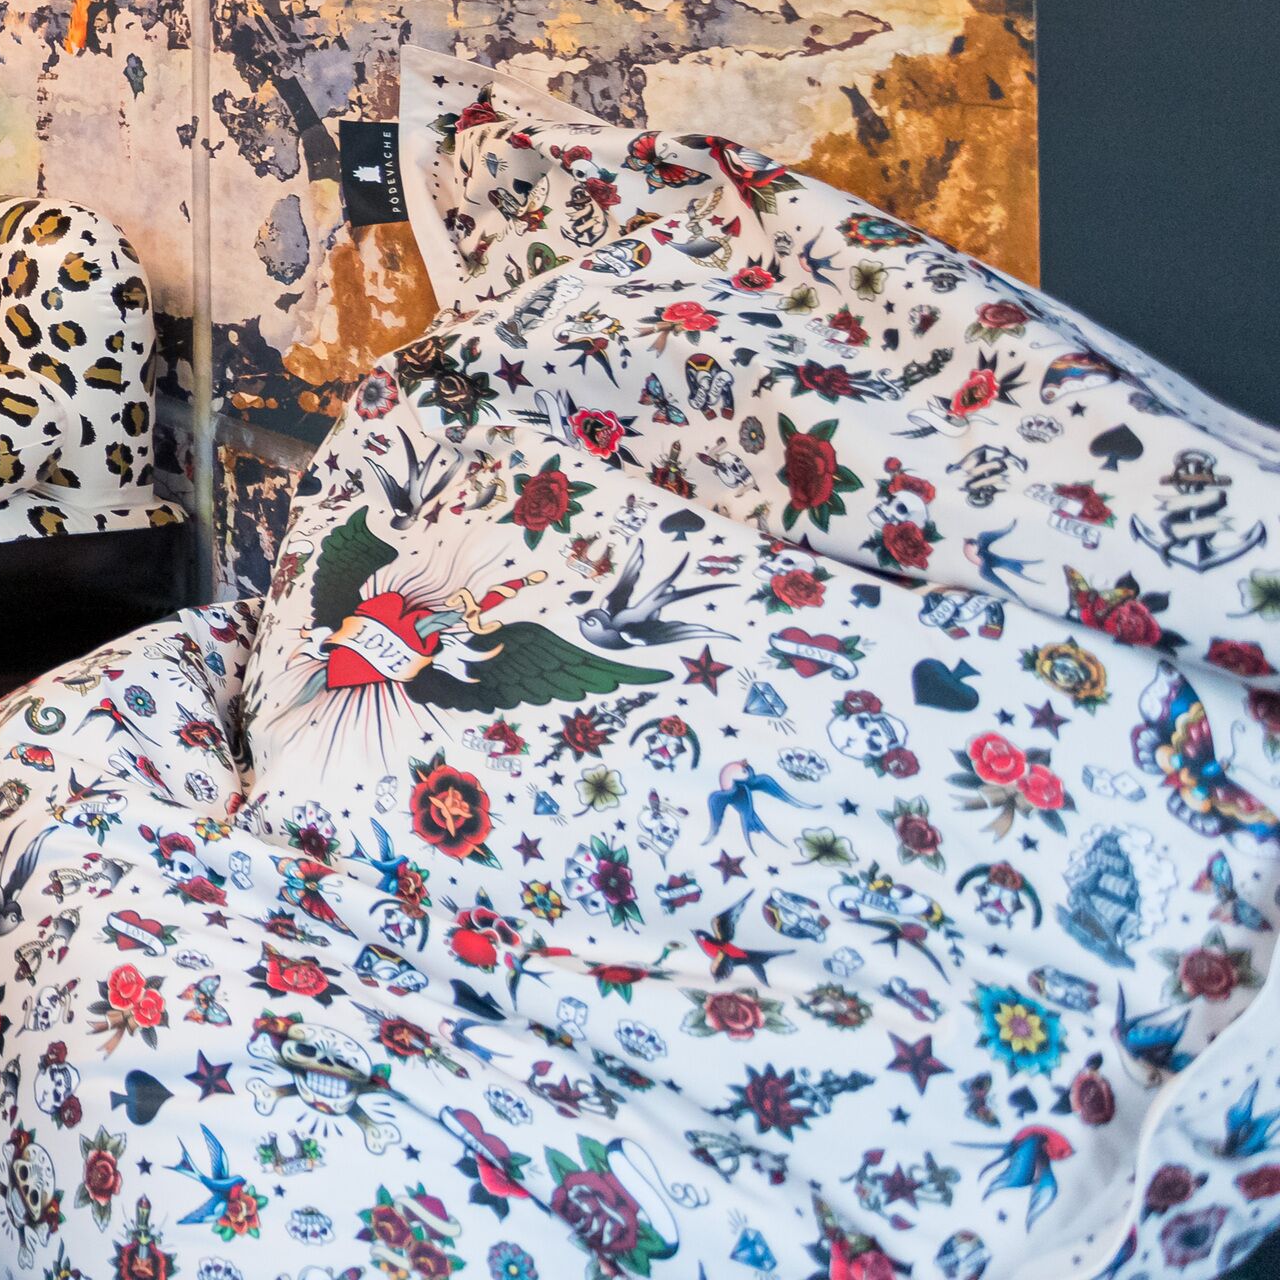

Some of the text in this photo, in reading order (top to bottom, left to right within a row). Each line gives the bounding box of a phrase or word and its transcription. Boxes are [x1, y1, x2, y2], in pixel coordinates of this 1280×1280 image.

[348, 624, 411, 674] LOVE
[796, 643, 837, 664] LOVE
[80, 802, 107, 813] SMILE
[124, 923, 155, 946] LOVE
